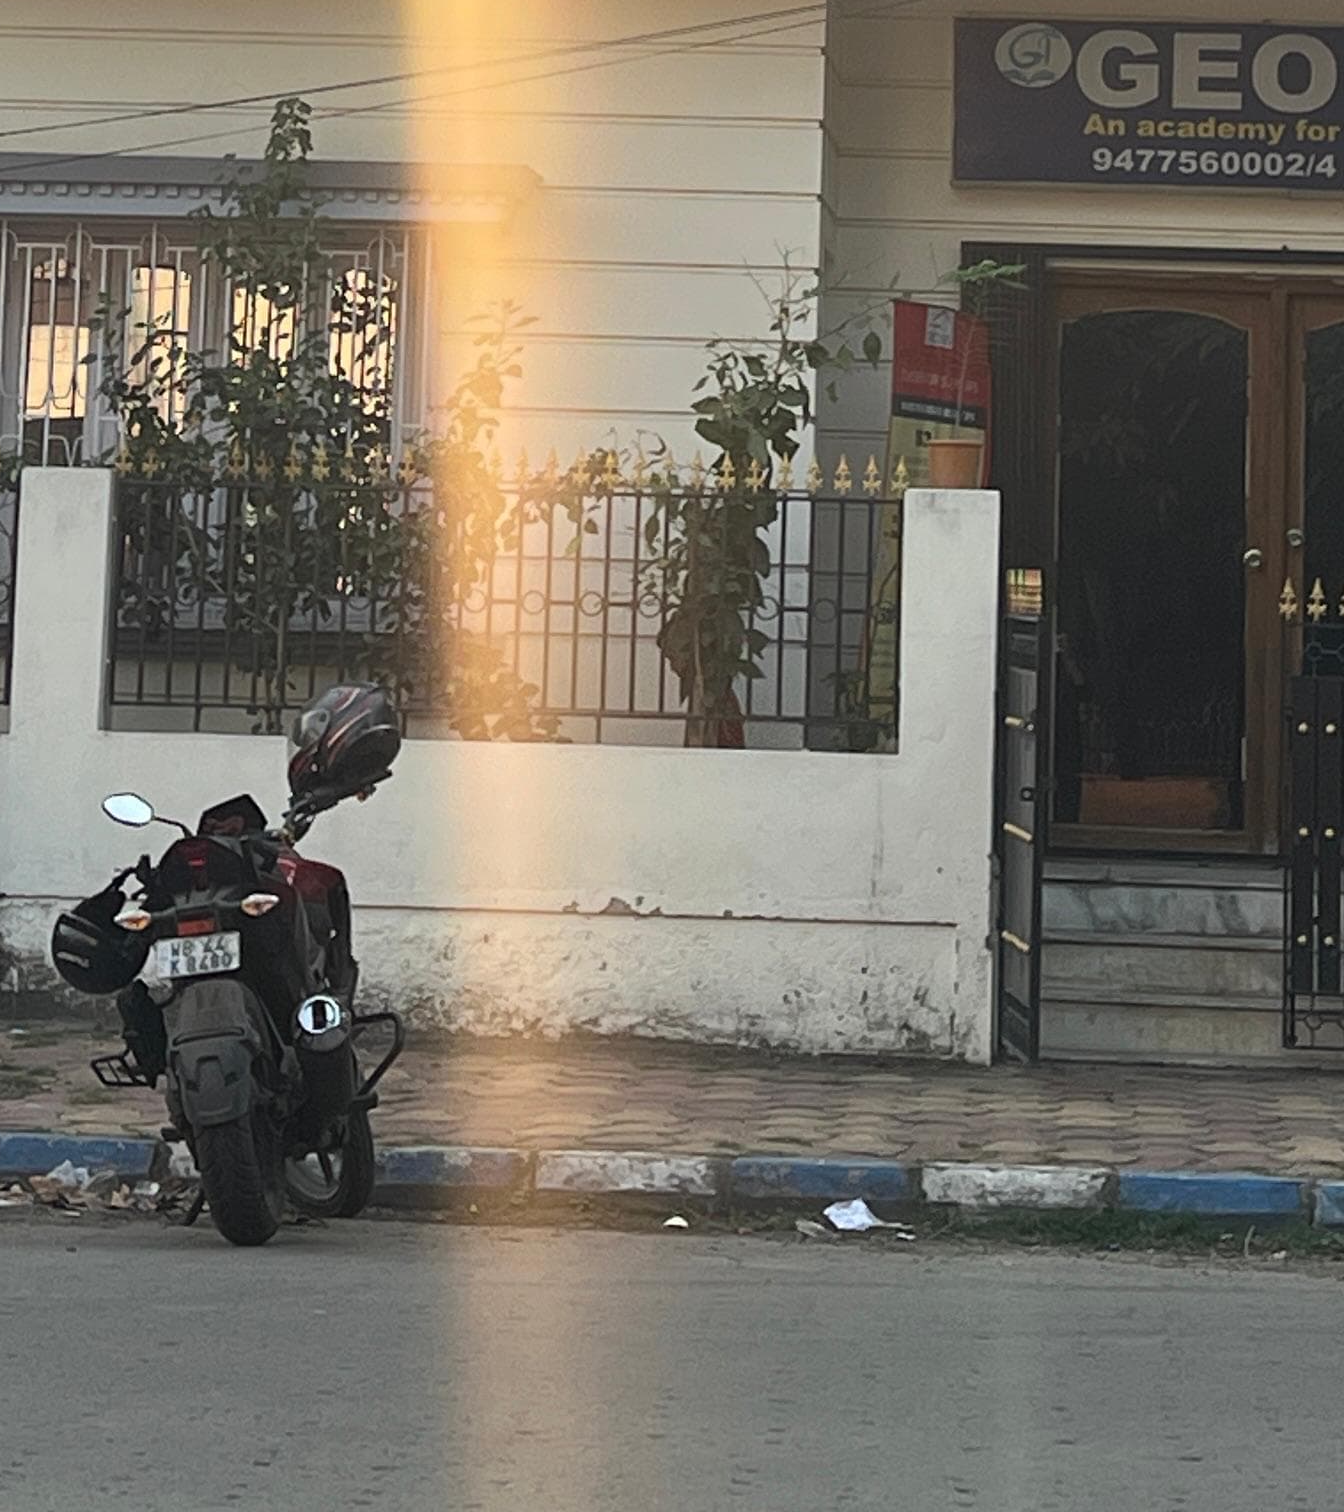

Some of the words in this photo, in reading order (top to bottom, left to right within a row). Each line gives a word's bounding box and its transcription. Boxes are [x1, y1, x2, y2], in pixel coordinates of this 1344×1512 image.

[1076, 29, 1337, 113] GEO
[1083, 113, 1126, 136] An
[1136, 115, 1286, 146] academy
[1295, 119, 1342, 142] for
[1092, 147, 1337, 179] 9477560002/4
